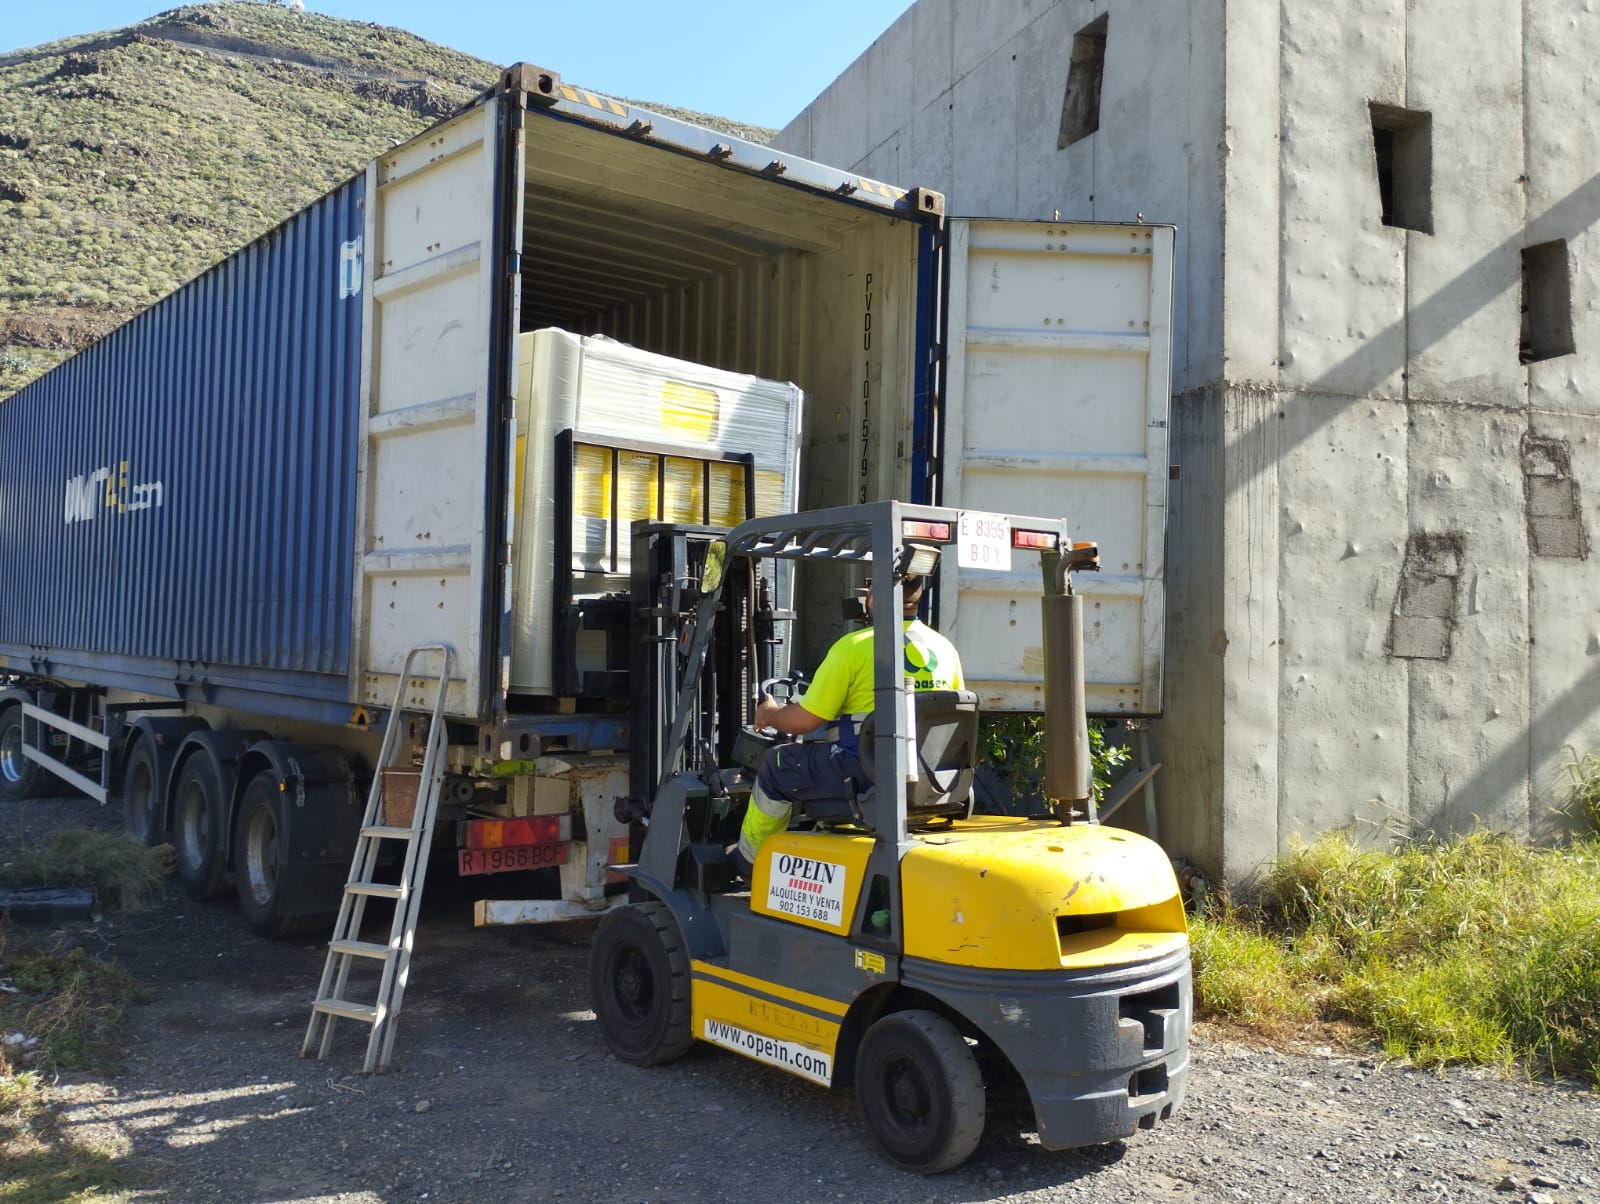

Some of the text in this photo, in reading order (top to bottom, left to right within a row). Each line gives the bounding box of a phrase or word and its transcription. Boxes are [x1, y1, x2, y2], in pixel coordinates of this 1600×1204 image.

[864, 273, 872, 351] PVDU
[861, 361, 869, 477] 101579
[961, 518, 1005, 539] E 8355
[463, 852, 473, 872] R
[481, 848, 528, 870] 1966
[779, 855, 837, 884] OPEIN
[770, 885, 840, 911] ALQUILER Y VENTA
[779, 900, 828, 921] 902 153 688
[709, 1020, 827, 1077] www.opein.com
